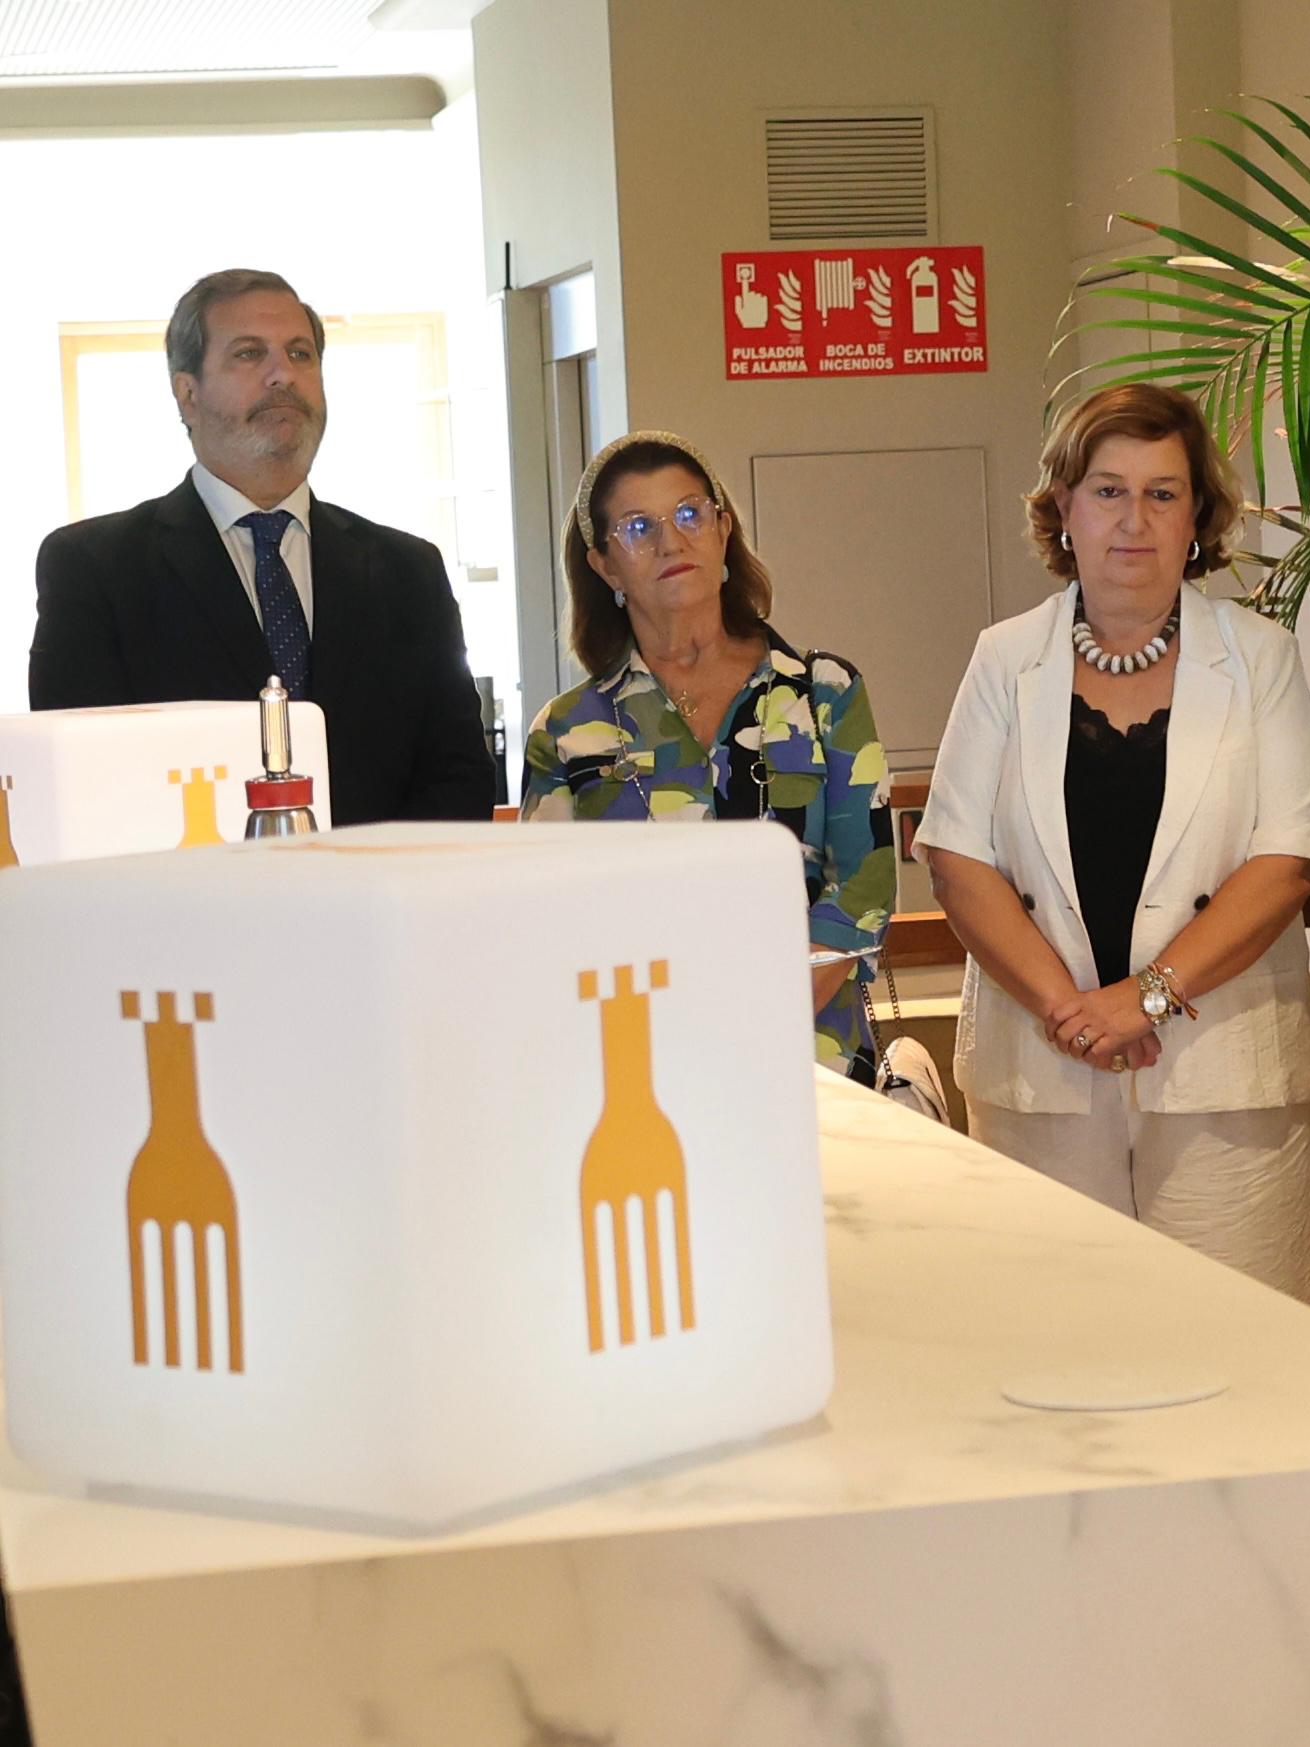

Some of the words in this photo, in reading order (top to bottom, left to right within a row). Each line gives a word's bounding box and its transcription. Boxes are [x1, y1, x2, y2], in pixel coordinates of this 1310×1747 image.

[732, 346, 805, 360] PULSADOR
[826, 344, 864, 357] BOCA
[867, 343, 886, 356] DE
[903, 346, 984, 364] EXTINTOR
[730, 361, 749, 374] DE
[751, 360, 808, 373] ALARMA
[819, 357, 894, 371] INCENDIOS
